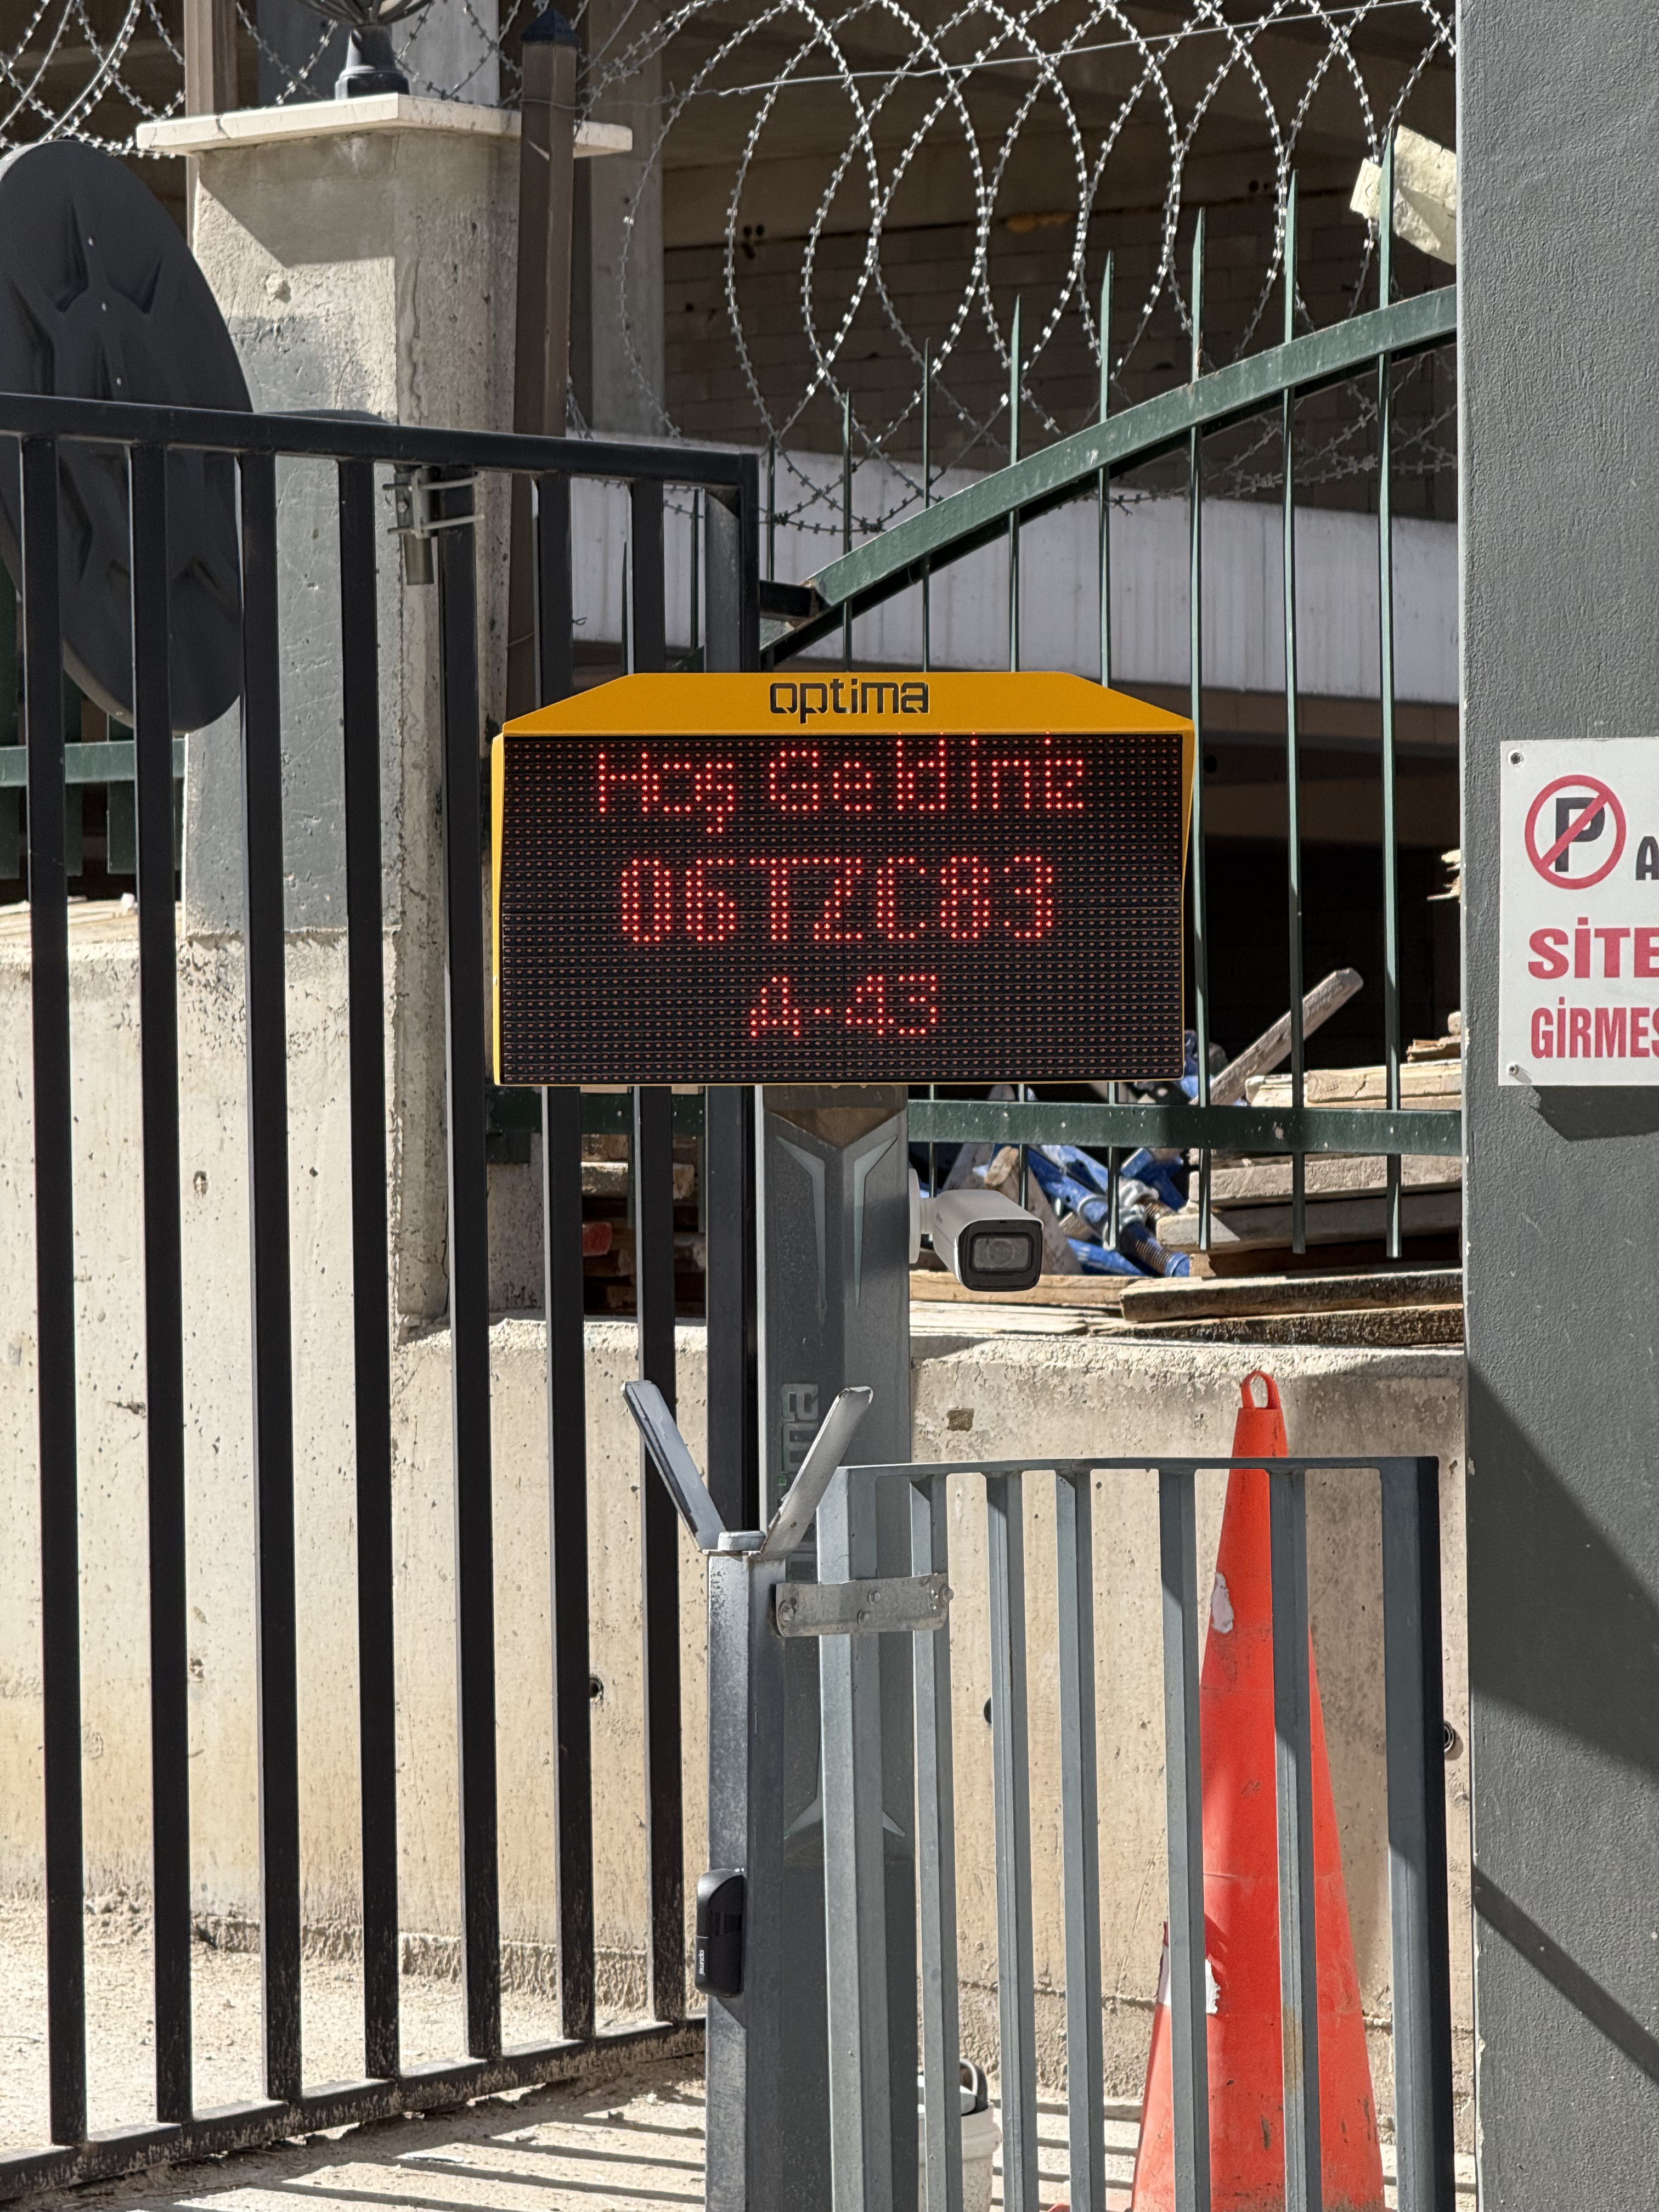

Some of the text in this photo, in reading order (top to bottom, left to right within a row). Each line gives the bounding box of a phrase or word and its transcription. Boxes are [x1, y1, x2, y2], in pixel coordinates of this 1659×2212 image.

[770, 678, 929, 724] optima
[621, 856, 1053, 942] 06TZC83
[750, 974, 937, 1037] A-43
